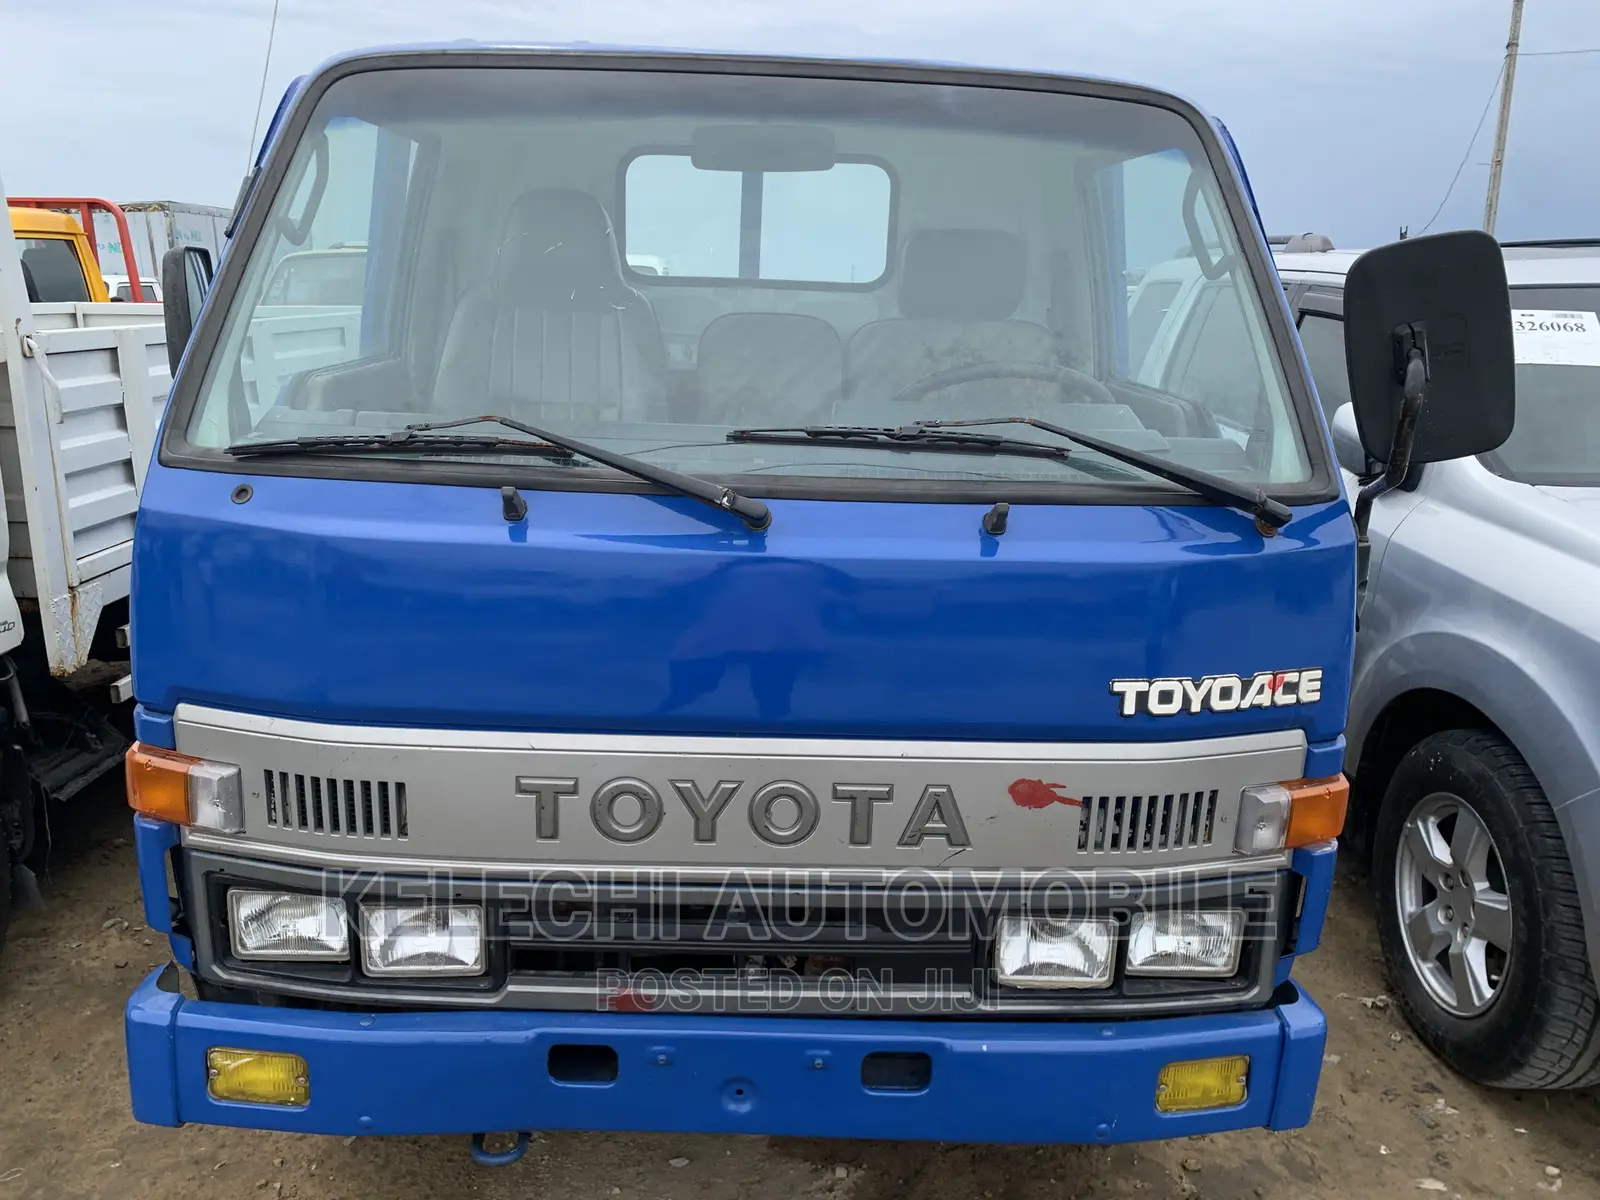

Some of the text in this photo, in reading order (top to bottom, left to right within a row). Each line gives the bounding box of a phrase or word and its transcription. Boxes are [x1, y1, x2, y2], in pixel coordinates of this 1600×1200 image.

[1514, 320, 1587, 333] 326068
[1110, 667, 1323, 717] TOYOACE
[515, 775, 973, 850] TOYOTA
